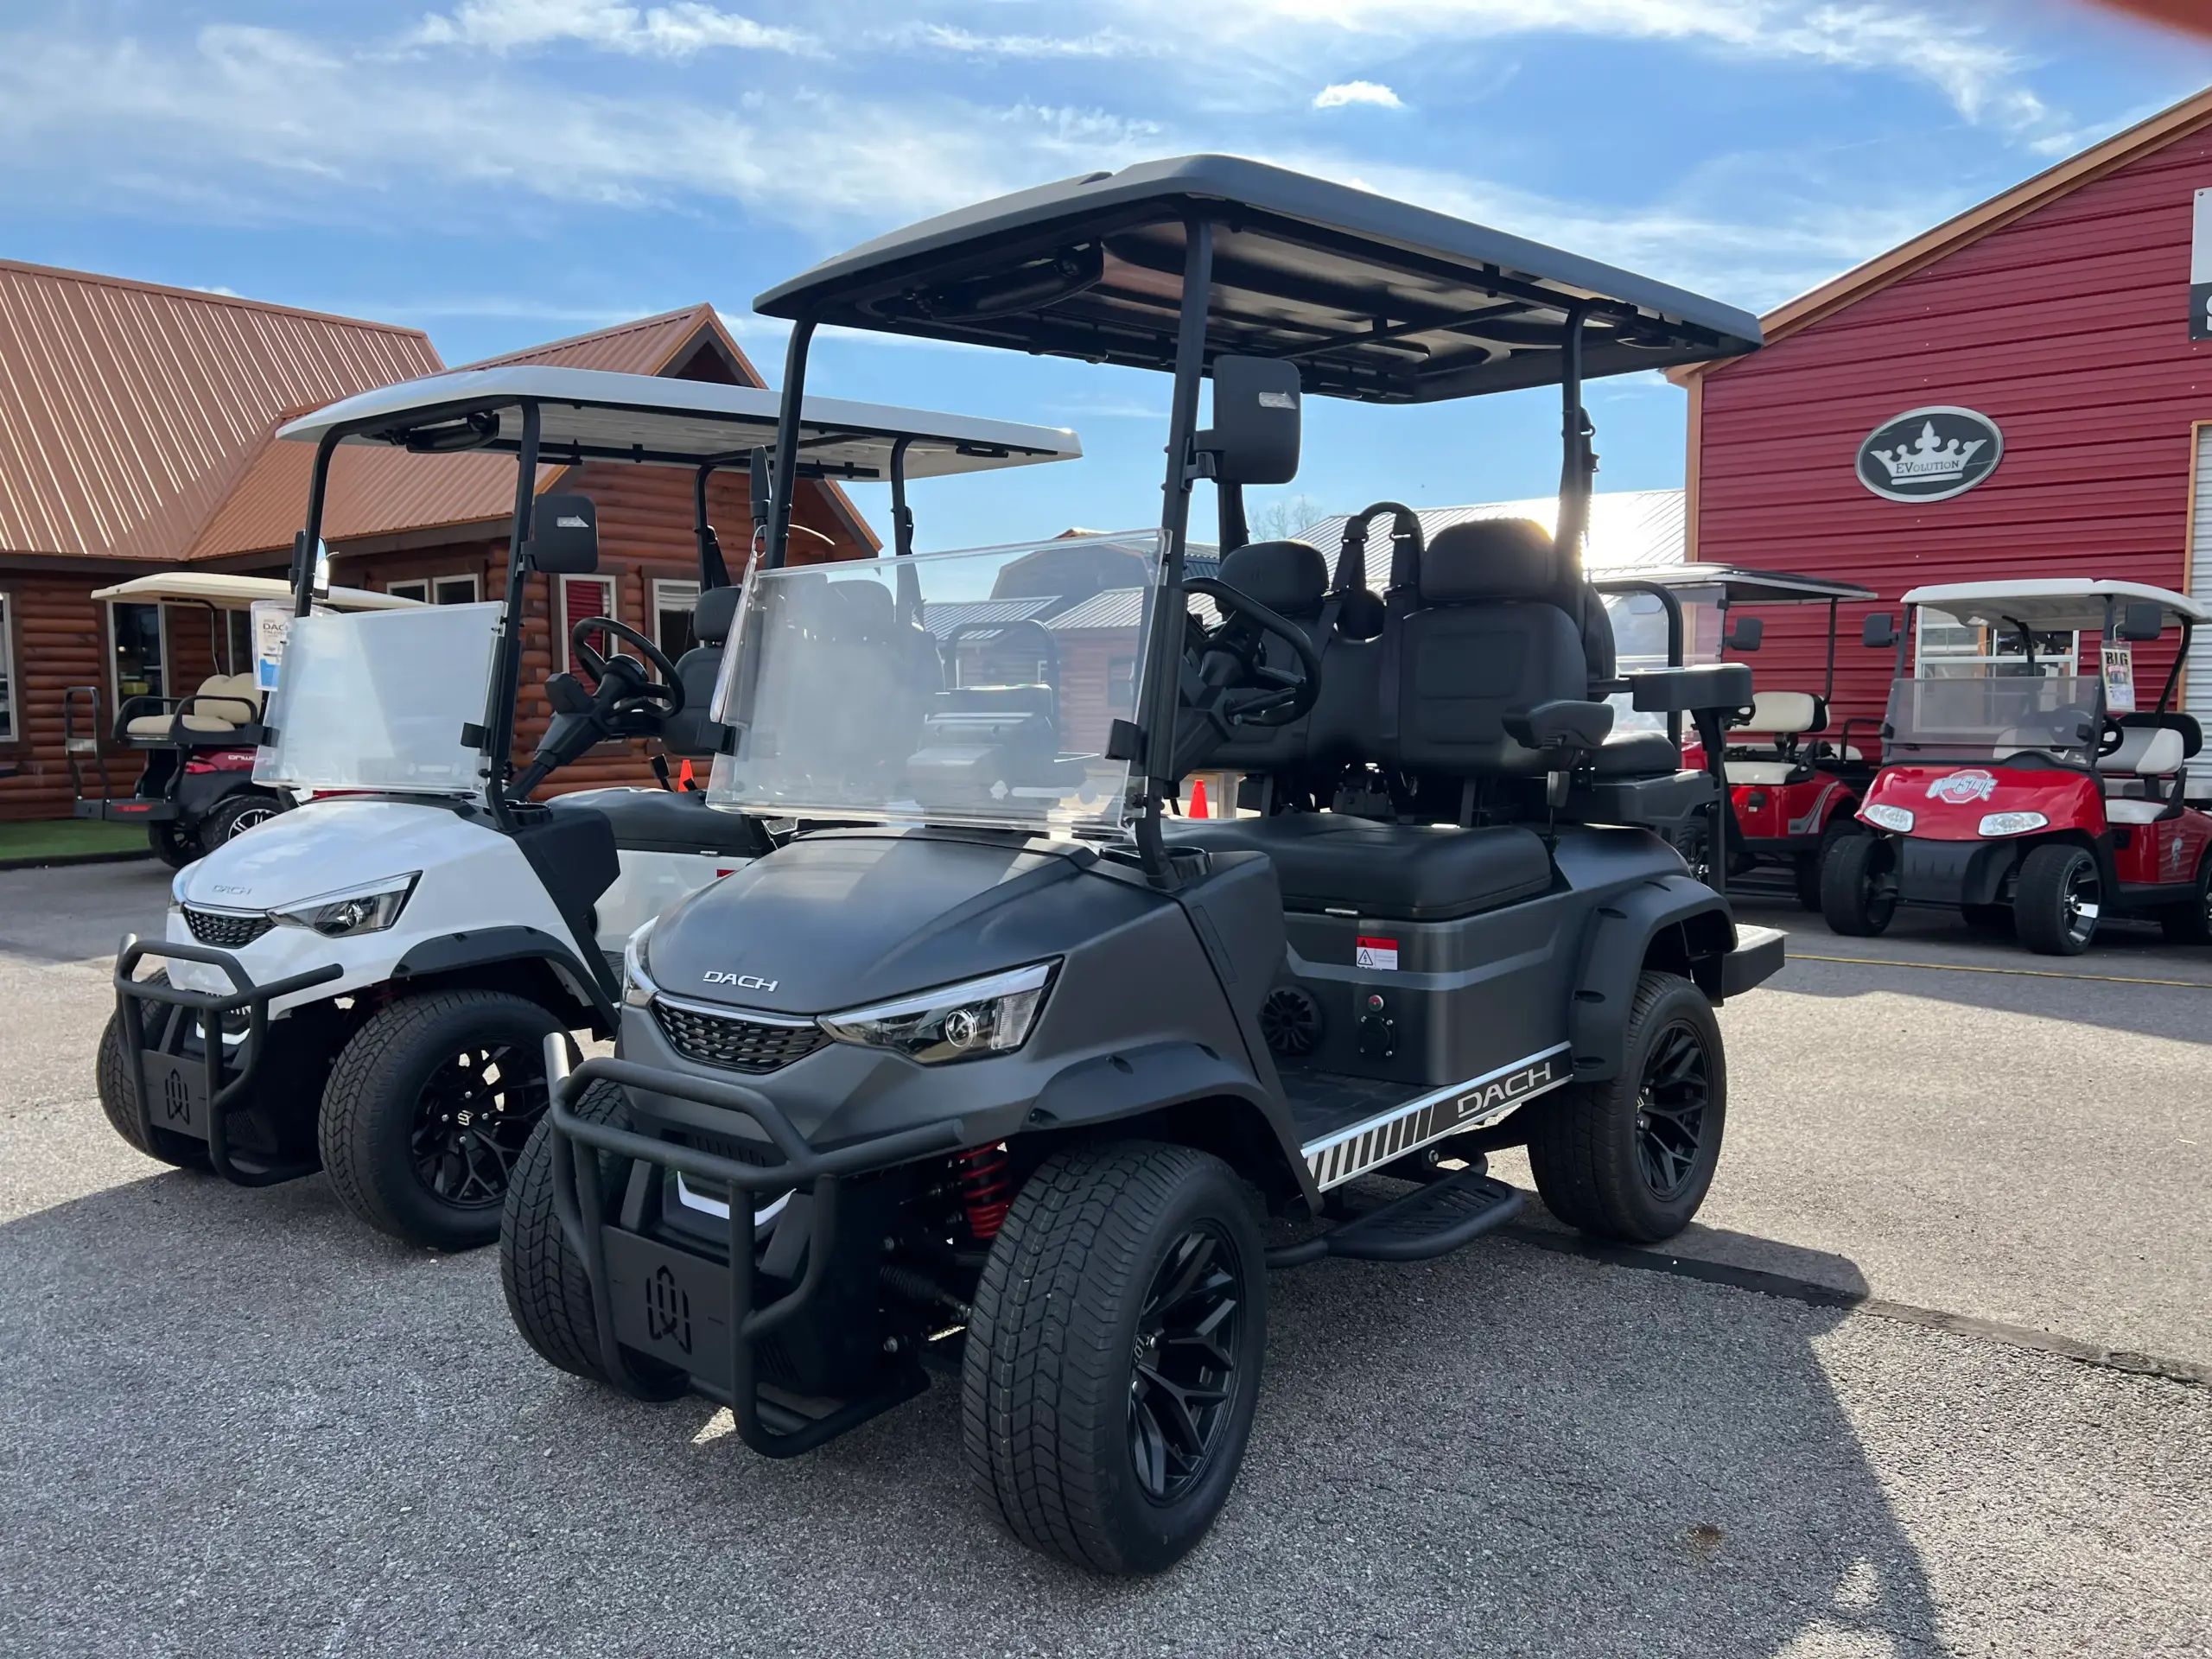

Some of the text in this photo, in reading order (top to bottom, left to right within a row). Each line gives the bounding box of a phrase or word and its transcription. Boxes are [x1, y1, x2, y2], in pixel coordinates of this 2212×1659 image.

[2106, 652, 2128, 665] BIG
[702, 970, 779, 992] DACH
[1457, 1061, 1552, 1118] DACH
